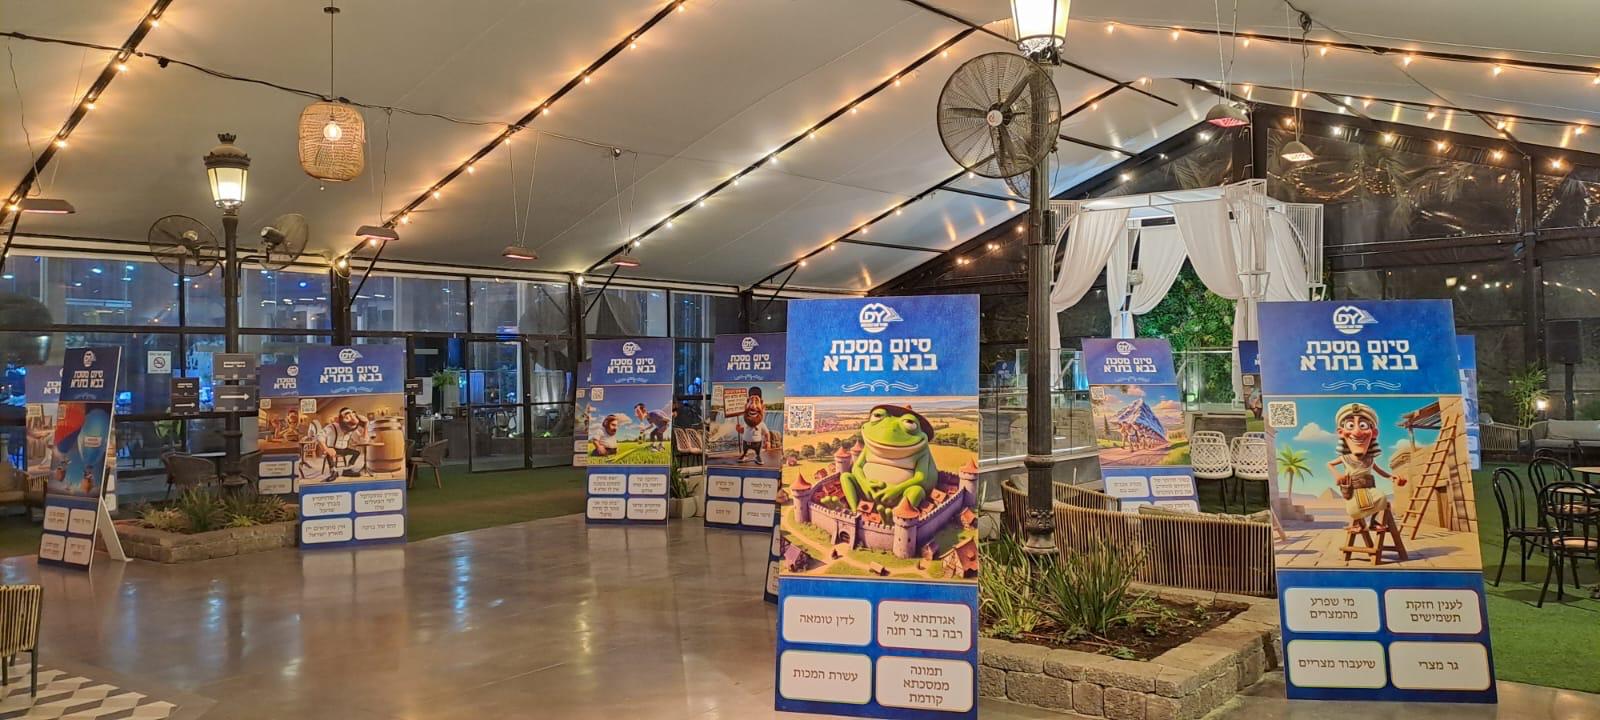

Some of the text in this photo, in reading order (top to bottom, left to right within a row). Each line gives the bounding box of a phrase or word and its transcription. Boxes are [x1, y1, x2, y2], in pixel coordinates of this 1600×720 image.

[830, 338, 931, 354] סיום מסכת
[1306, 340, 1409, 354] סיום מסכת
[727, 362, 771, 370] בבא בתרא
[823, 354, 938, 372] בבא בתרא
[1300, 354, 1419, 371] בבא בתרא
[607, 366, 633, 374] בתרא
[90, 379, 104, 388] בבא
[320, 373, 383, 384] בבא בתרא
[1310, 598, 1339, 607] שפרע
[1406, 599, 1463, 611] לענין חזקת
[800, 614, 855, 627] לדין טומאה
[894, 611, 955, 625] אגדתתא של
[1310, 610, 1358, 620] מהמצרים
[1410, 613, 1461, 622] תשמישים
[887, 626, 963, 639] רבה בר בר חנה
[1299, 659, 1376, 669] שיעבוד מצריים
[1418, 661, 1459, 670] גר מצרי
[793, 669, 858, 682] עשרת המכות
[910, 666, 943, 676] תמונה
[903, 680, 950, 691] ממסכתא
[909, 693, 943, 706] קודמת
